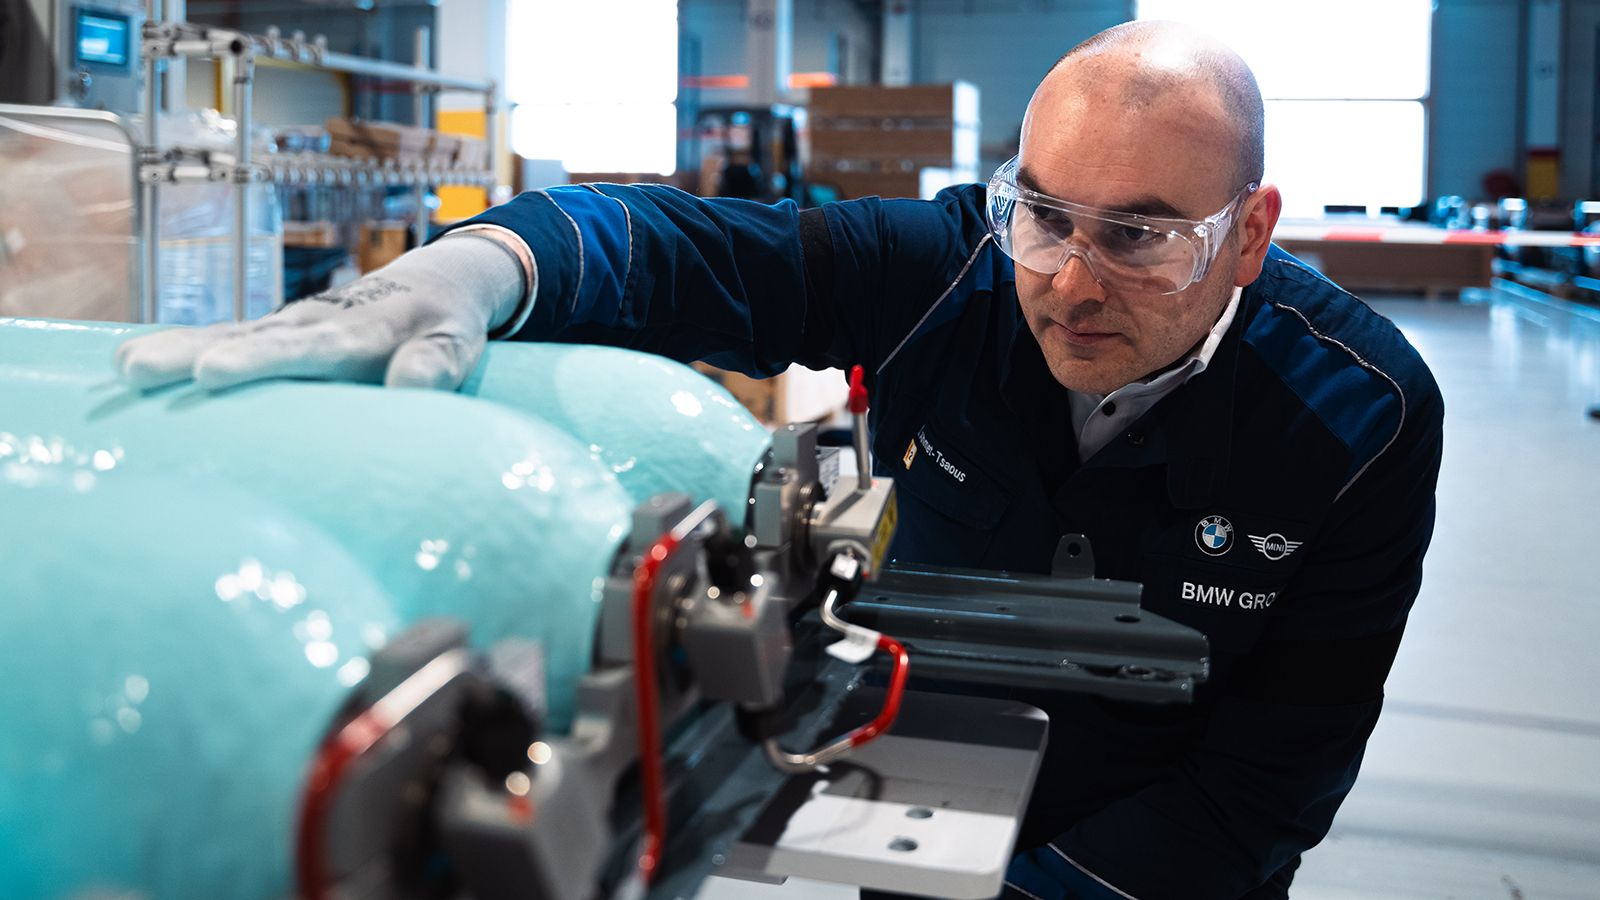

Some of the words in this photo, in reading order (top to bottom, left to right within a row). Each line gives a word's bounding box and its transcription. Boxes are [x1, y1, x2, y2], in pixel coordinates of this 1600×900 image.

[1200, 517, 1232, 533] BMW
[1265, 542, 1286, 552] MINI
[1182, 582, 1235, 607] BMW
[1239, 592, 1279, 610] GRO
